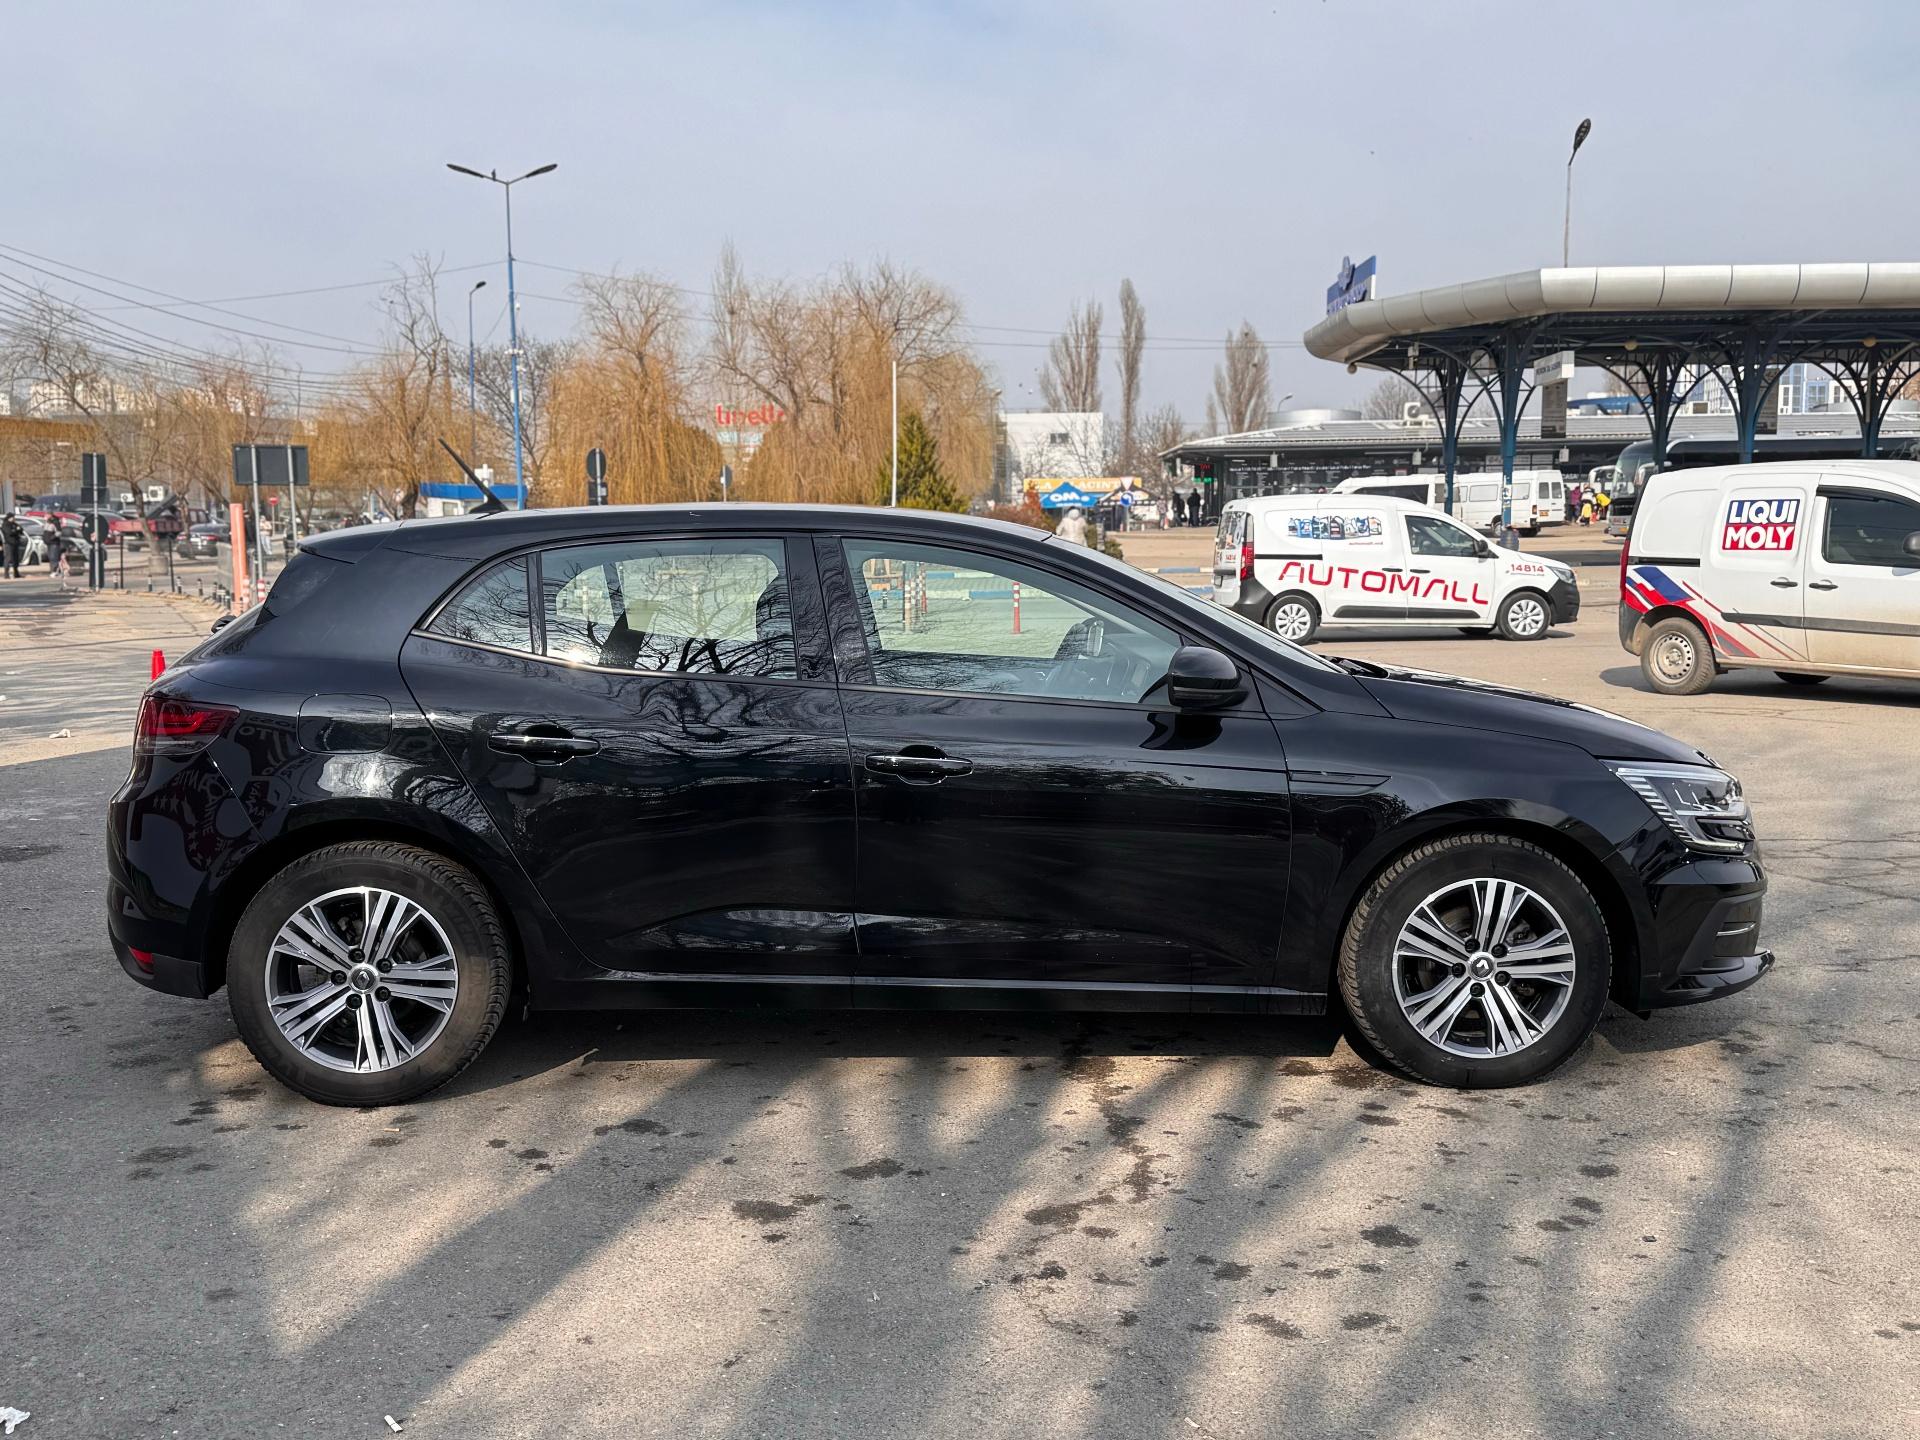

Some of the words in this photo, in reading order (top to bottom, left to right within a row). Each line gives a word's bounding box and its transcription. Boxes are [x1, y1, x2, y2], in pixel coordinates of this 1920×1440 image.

[1728, 500, 1798, 525] LIQUI
[1724, 526, 1795, 549] MOLY
[1511, 563, 1545, 573] 14814
[1279, 561, 1488, 605] AUTOMALL
